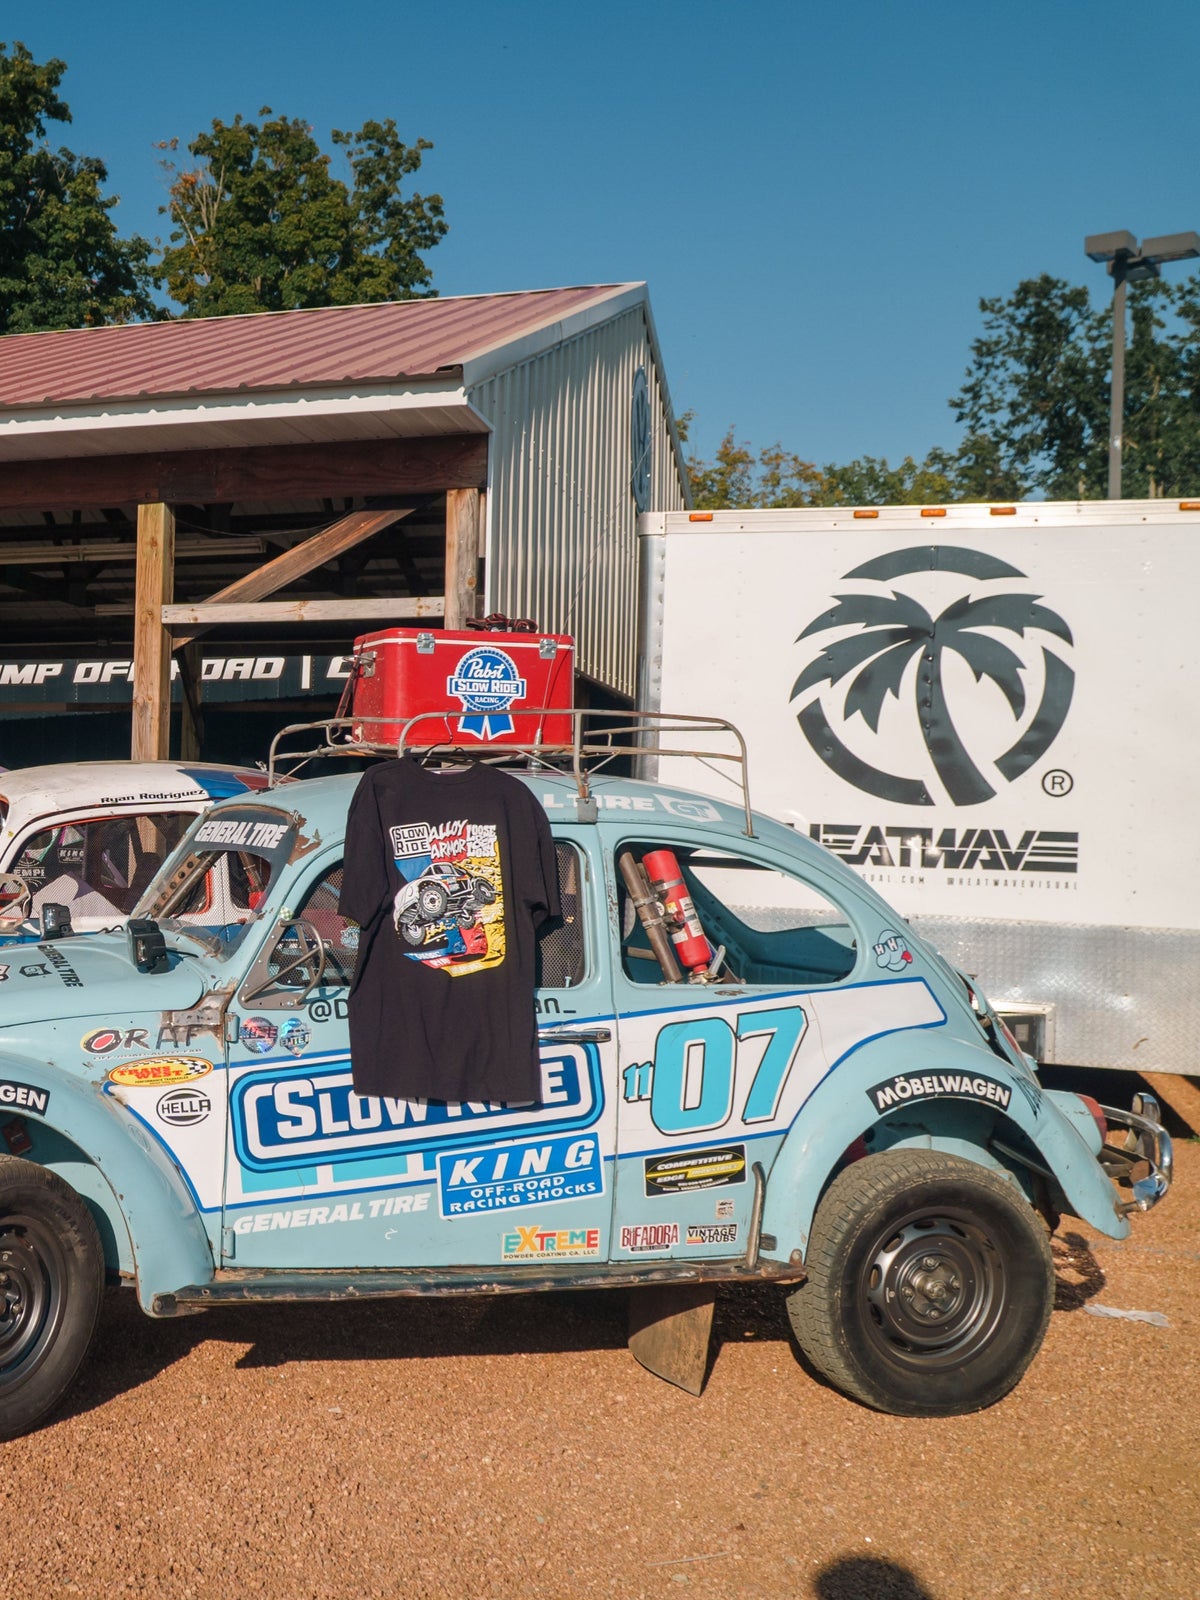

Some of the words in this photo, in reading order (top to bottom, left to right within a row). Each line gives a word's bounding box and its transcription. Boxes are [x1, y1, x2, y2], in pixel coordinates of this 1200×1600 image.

[73, 652, 135, 684] OF
[467, 657, 505, 679] Pabst
[458, 680, 488, 692] SLOW
[490, 681, 518, 693] RIDE
[474, 696, 500, 704] RACING
[101, 796, 135, 804] Ryan
[139, 789, 206, 801] Rodriguez
[194, 820, 253, 846] GENERAL
[245, 822, 289, 849] TIRE
[395, 827, 425, 841] SLOW
[429, 819, 469, 842] ALLOY
[396, 840, 429, 854] RIDE
[430, 839, 466, 859] ARMOR
[878, 1075, 1011, 1110] MÖBELWAGEN
[161, 1097, 212, 1115] HELLA
[448, 1139, 596, 1187] KING
[657, 1153, 733, 1171] COMPETITIVE
[470, 1176, 565, 1199] OFF-ROAD
[656, 1173, 686, 1184] EDGE
[450, 1190, 526, 1213] RACING
[528, 1181, 597, 1204] SHOCKS
[232, 1202, 365, 1236] GENERAL
[367, 1192, 432, 1218] TIRE
[504, 1226, 599, 1253] EXTREME
[687, 1227, 735, 1238] VINTAGE
[701, 1235, 737, 1244] VDUBS
[504, 1252, 534, 1260] POWDER
[536, 1249, 567, 1258] COATING
